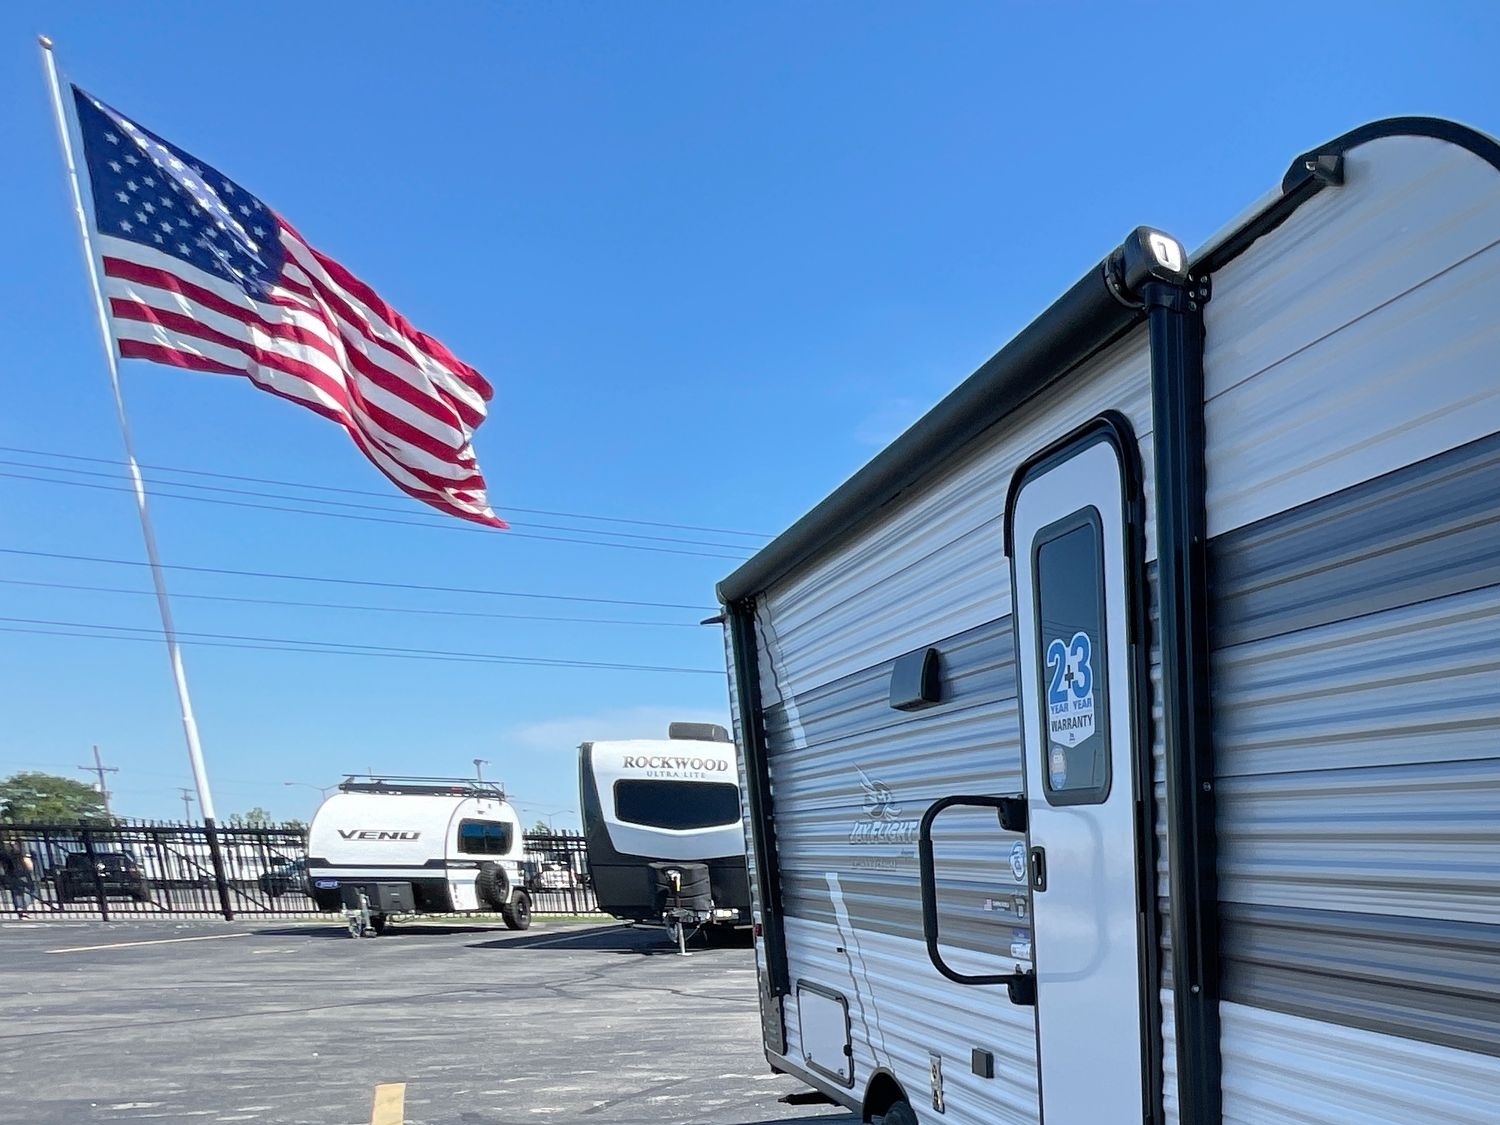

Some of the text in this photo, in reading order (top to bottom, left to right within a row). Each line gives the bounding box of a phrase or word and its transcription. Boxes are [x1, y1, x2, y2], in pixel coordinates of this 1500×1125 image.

[1051, 698, 1092, 715] YEAR YEAR
[1051, 714, 1093, 733] WARRANTY
[622, 756, 728, 771] ROCKWOOD
[337, 829, 421, 841] VENU
